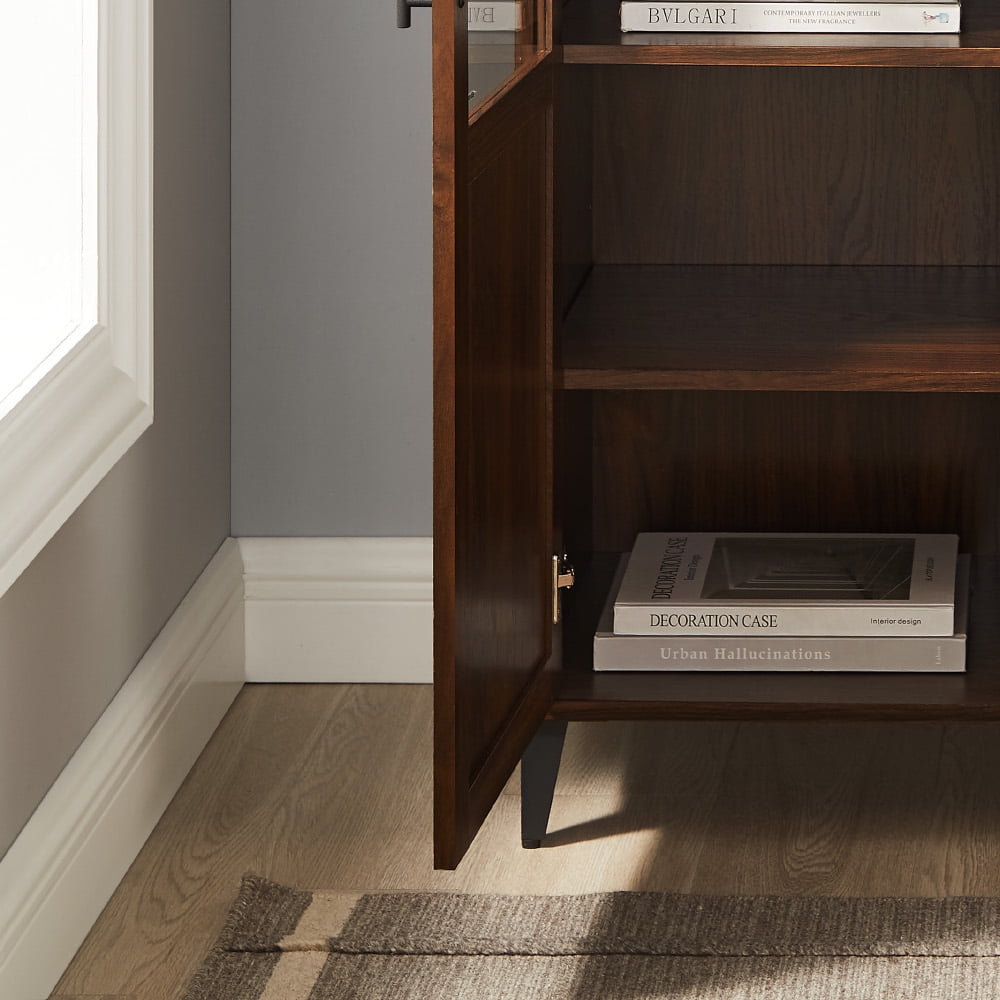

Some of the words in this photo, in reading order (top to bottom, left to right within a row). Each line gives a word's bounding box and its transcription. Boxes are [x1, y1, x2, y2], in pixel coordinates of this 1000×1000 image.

[648, 7, 737, 25] BVLGARI
[650, 614, 740, 627] DECORATION
[742, 614, 778, 628] CASE
[897, 618, 922, 626] design
[660, 647, 708, 660] Urban
[714, 647, 831, 660] Hallucinations
